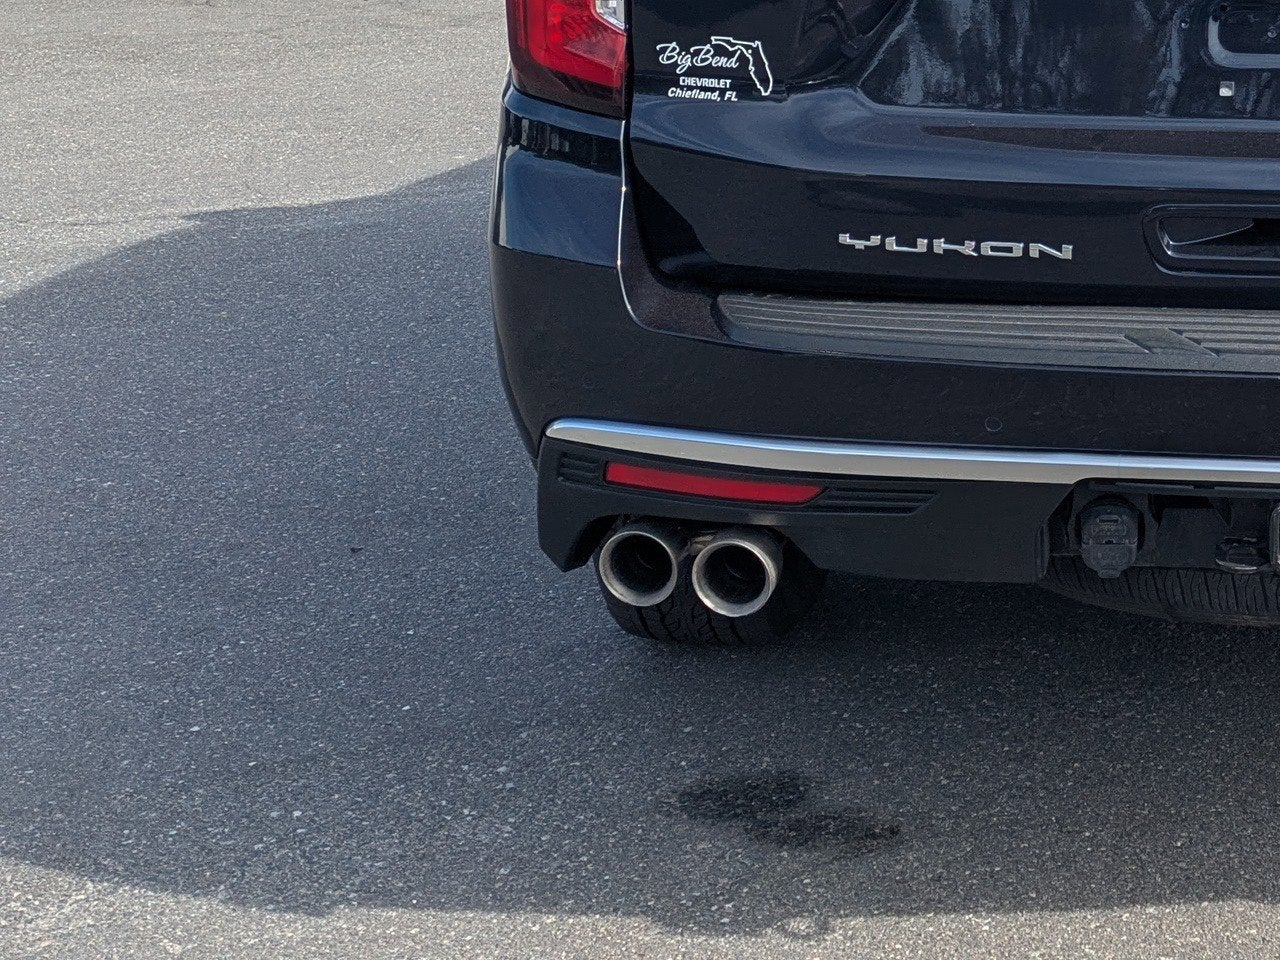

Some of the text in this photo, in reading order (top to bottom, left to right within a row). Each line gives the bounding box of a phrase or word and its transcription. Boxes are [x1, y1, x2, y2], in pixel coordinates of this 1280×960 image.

[656, 42, 741, 74] Big Bend
[679, 76, 732, 88] CHEVROLET
[667, 87, 738, 102] Chiefland, FL
[838, 233, 1073, 260] YUKON
